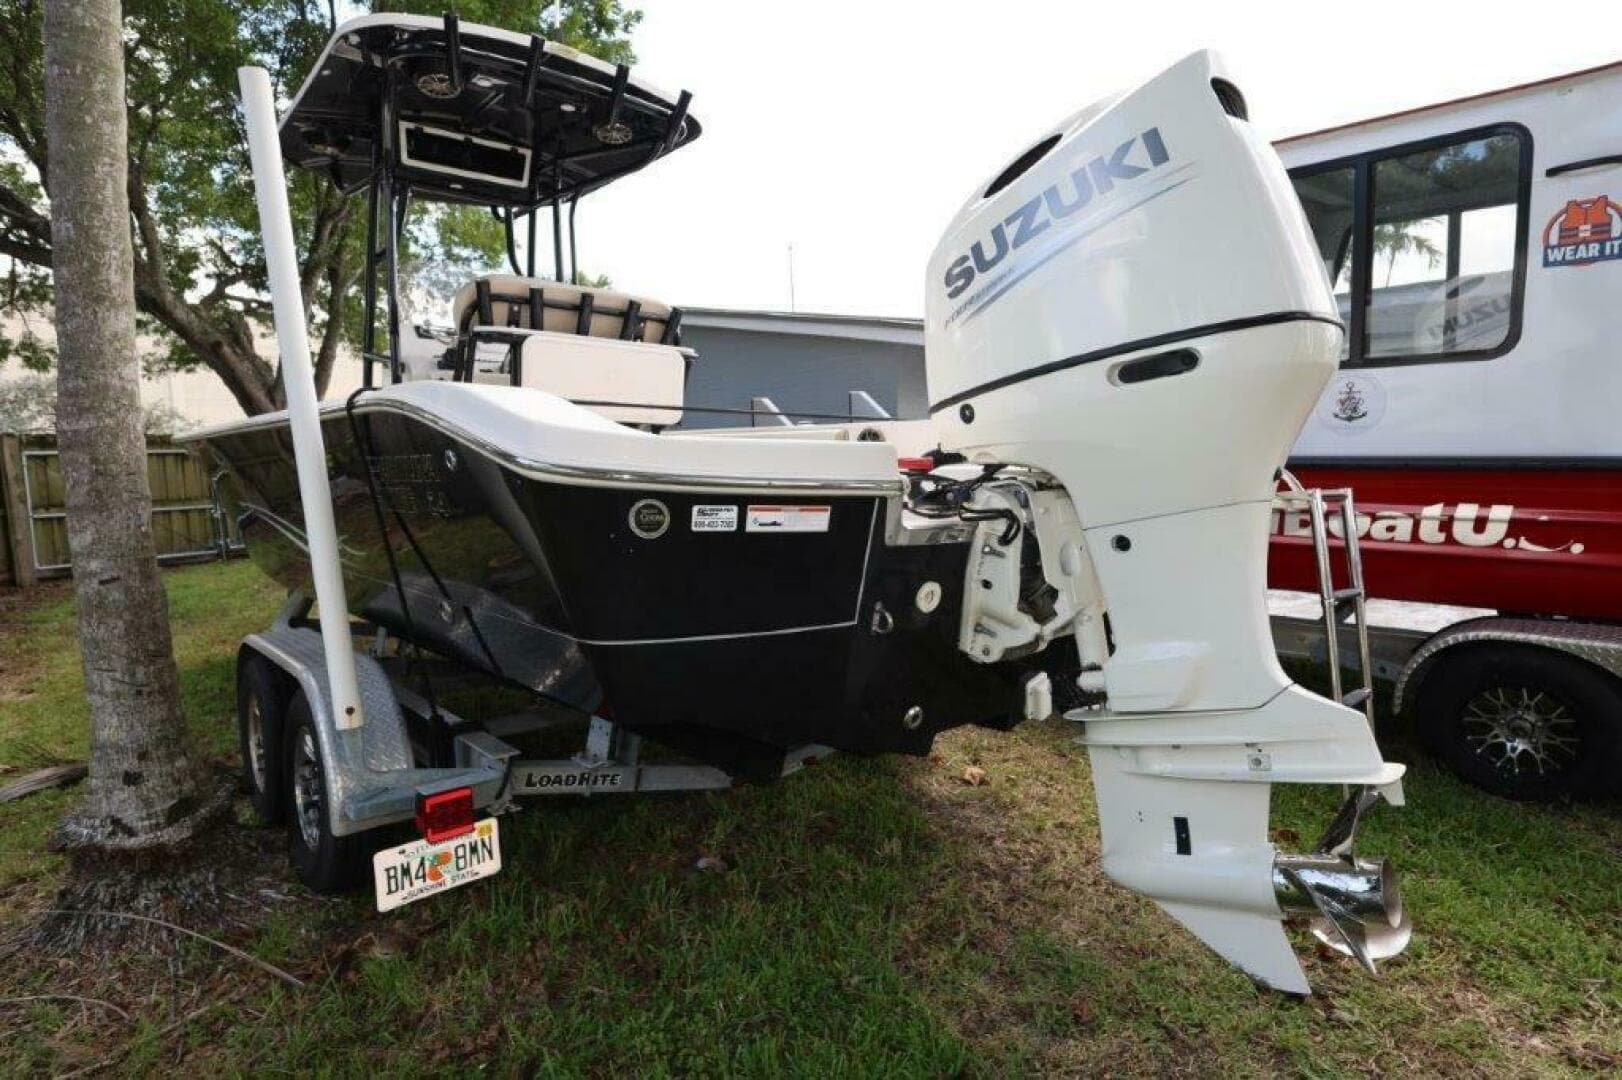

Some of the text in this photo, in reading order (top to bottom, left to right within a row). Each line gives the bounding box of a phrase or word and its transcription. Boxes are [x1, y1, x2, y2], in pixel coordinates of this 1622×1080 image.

[944, 126, 1170, 299] SUZUKI
[1547, 243, 1600, 262] WEAR
[525, 772, 621, 787] LOADRITE
[384, 856, 427, 896] BM4
